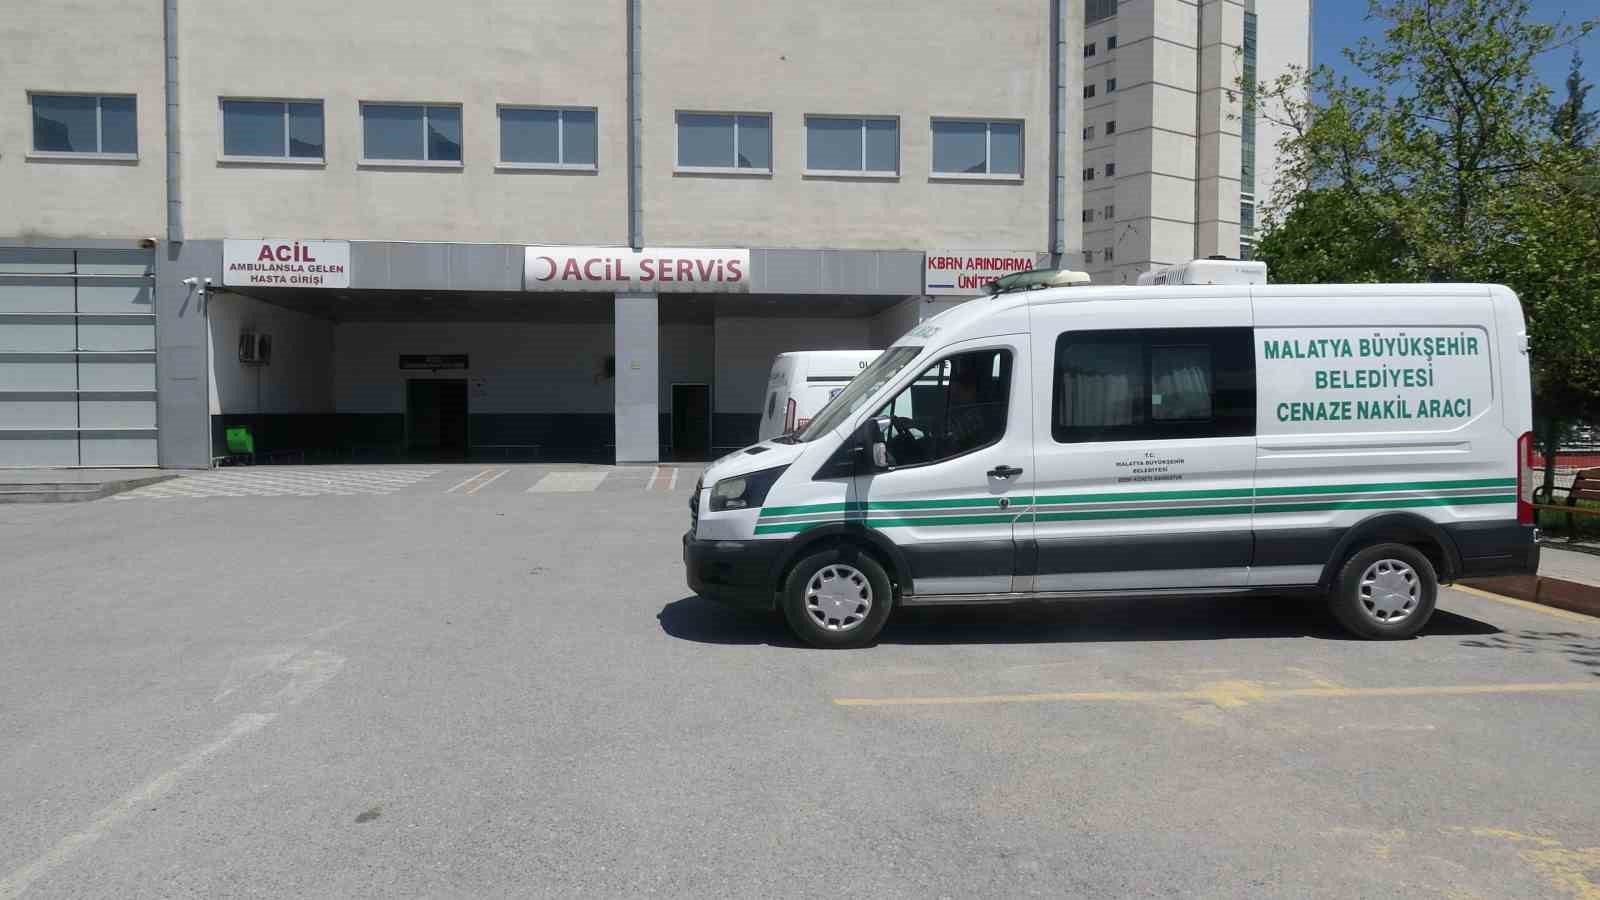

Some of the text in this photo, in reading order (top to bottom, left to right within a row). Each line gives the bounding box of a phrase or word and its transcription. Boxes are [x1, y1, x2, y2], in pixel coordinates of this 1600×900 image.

[257, 242, 316, 262] ACİL
[229, 263, 344, 273] AMBULANSLA GELEN
[928, 256, 1033, 271] KBRN ARINDIRMA
[250, 274, 323, 285] HASTA GİRİŞİ
[1264, 332, 1479, 361] MALATYA BÜYÜKŞEHİR
[1315, 363, 1434, 389] BELEDİYESİ
[1277, 395, 1472, 422] CENAZE NAKİL ARACI
